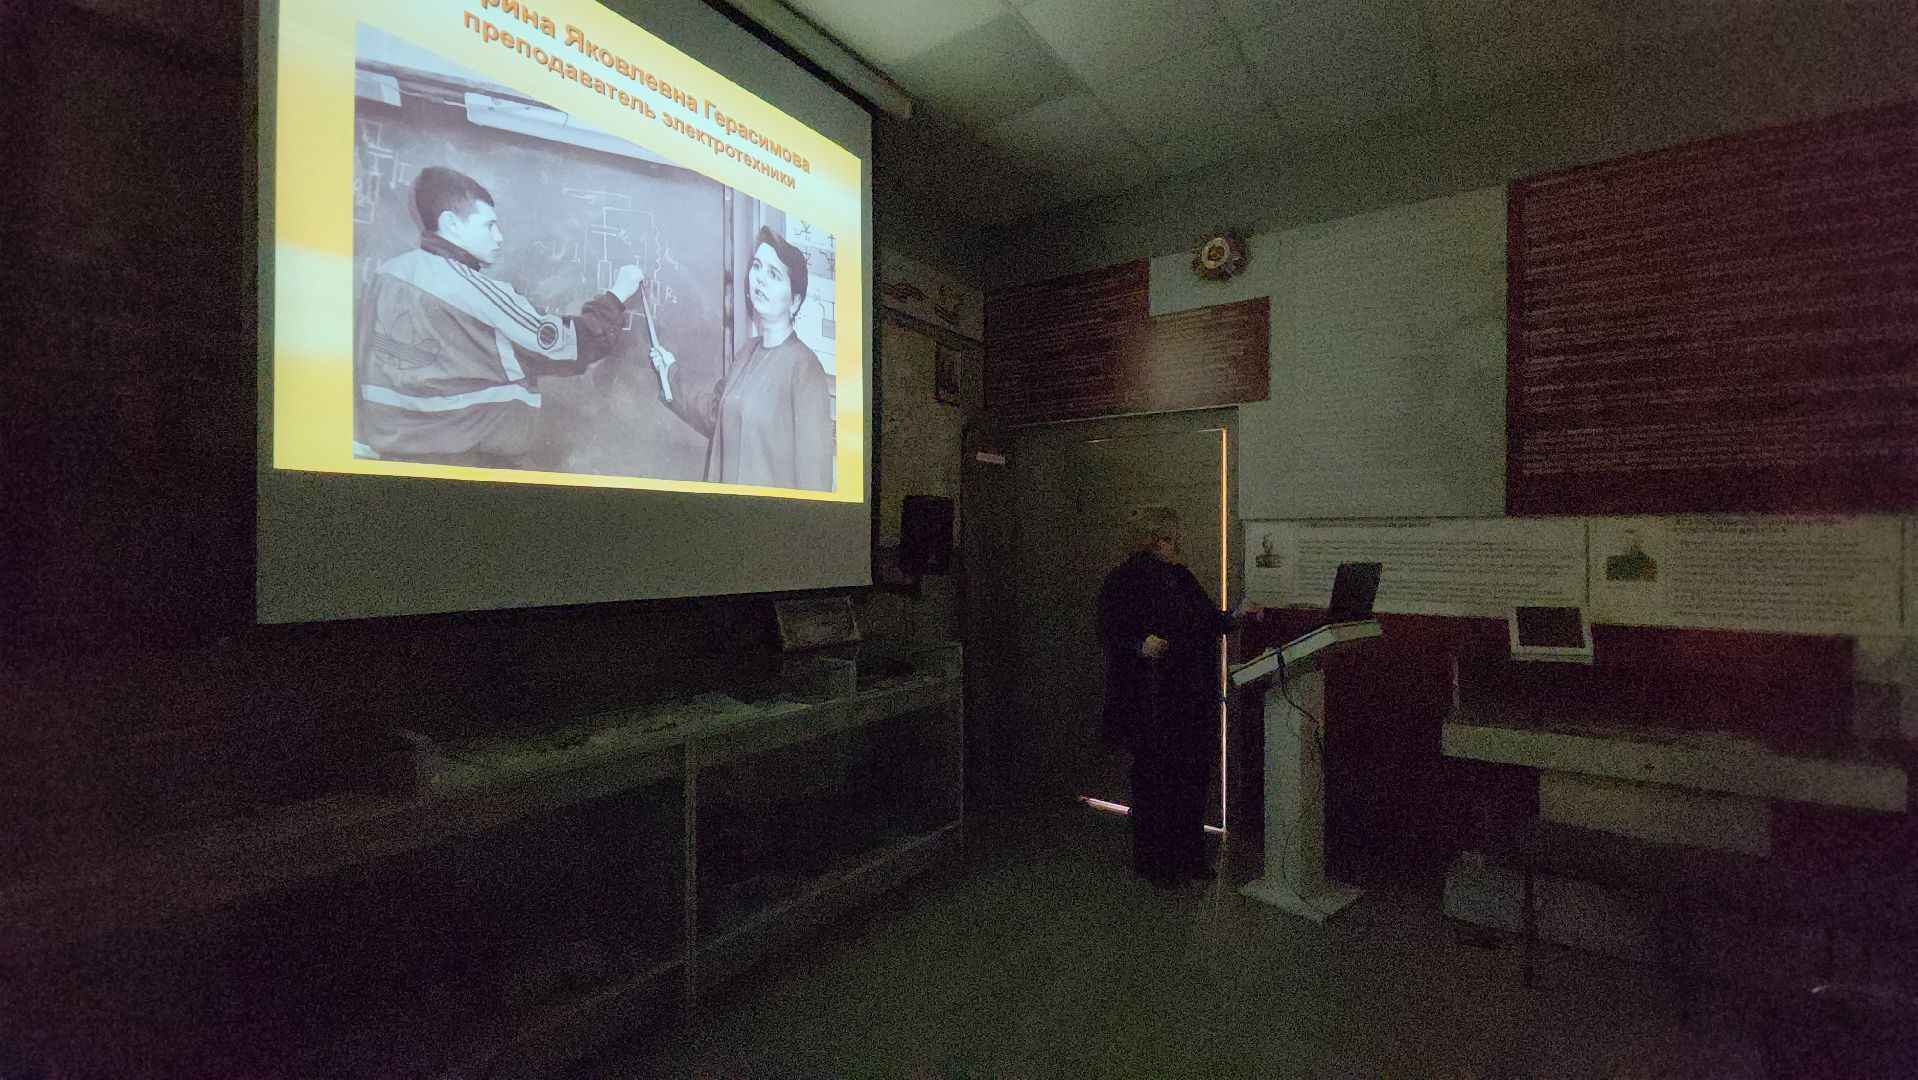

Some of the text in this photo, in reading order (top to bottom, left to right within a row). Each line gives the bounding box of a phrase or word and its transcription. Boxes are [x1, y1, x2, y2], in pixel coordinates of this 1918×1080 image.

[463, 10, 797, 189] преподаватель электротехники
[564, 24, 698, 114] Яковлевна
[704, 98, 811, 174] Герасимова
